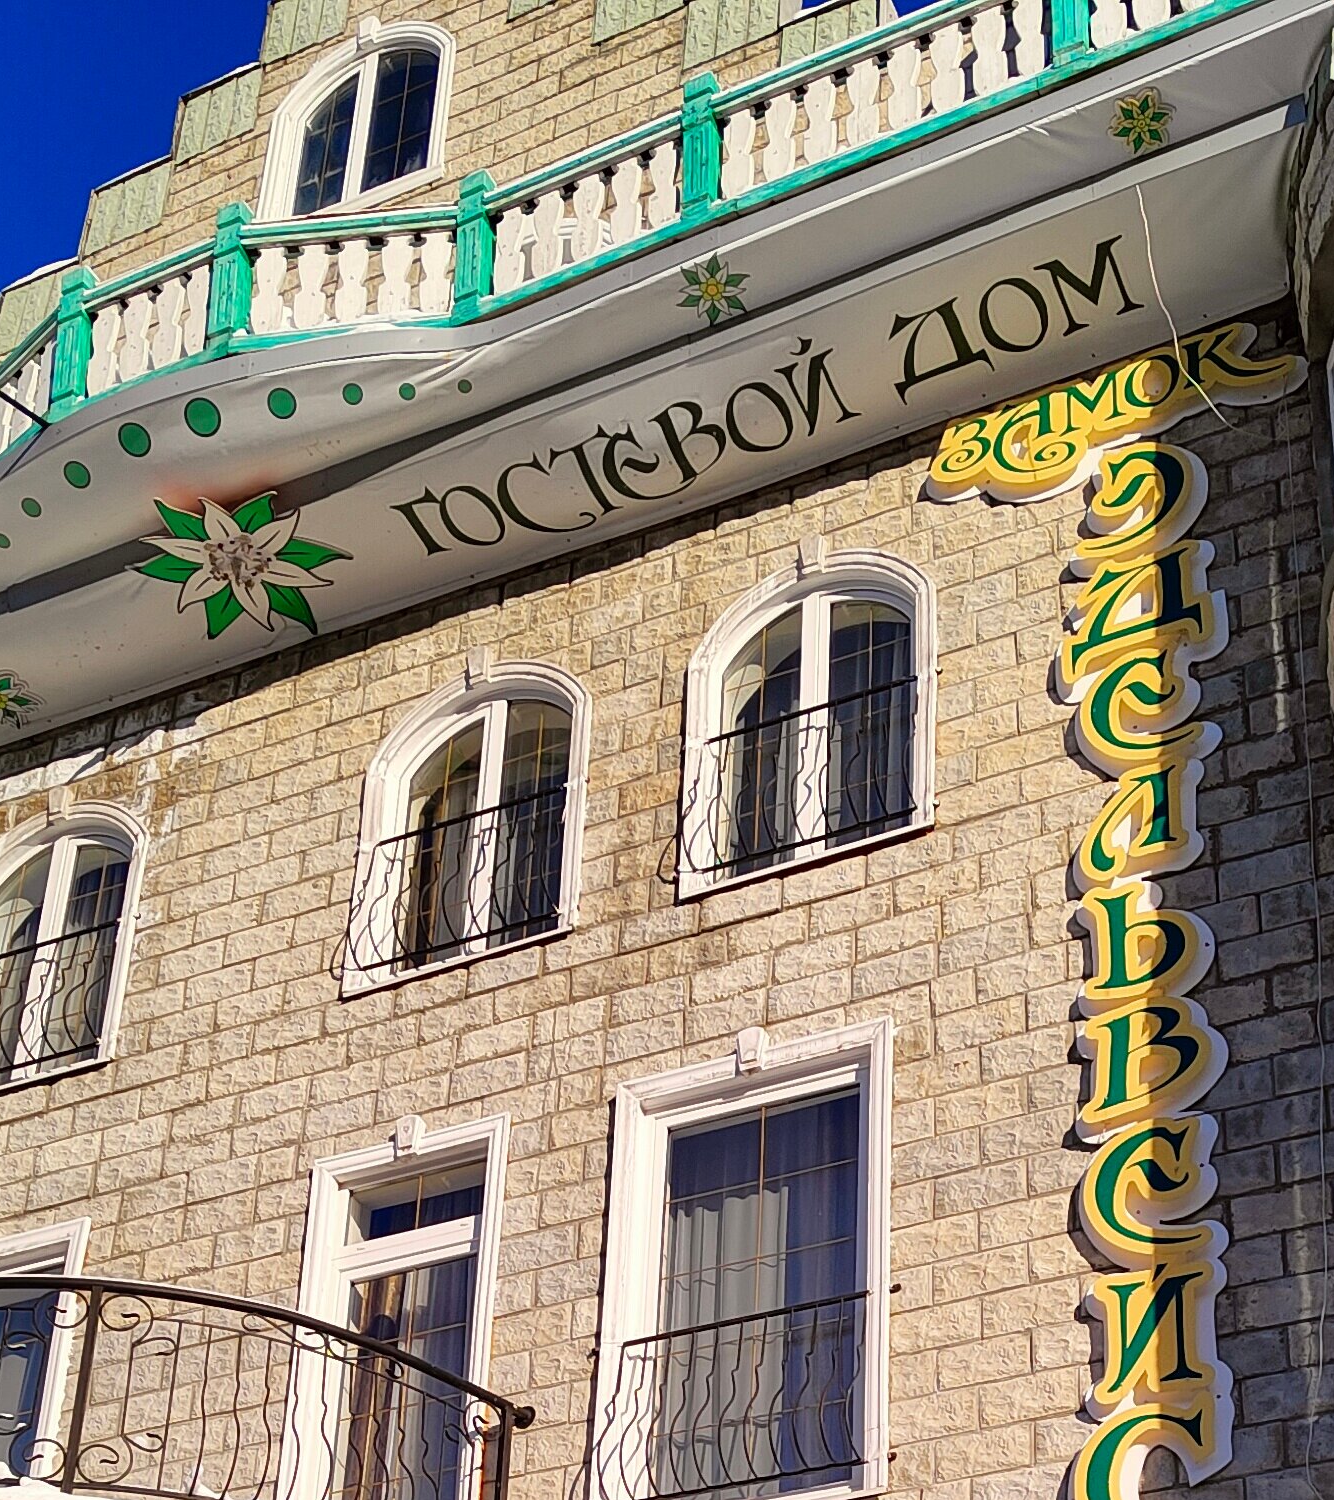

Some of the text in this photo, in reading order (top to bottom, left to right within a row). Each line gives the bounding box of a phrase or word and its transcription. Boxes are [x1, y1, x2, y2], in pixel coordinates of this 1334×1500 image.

[389, 234, 1145, 556] ГОСТЕВОЙ ДОМ
[940, 330, 1289, 474] ЗАМОК
